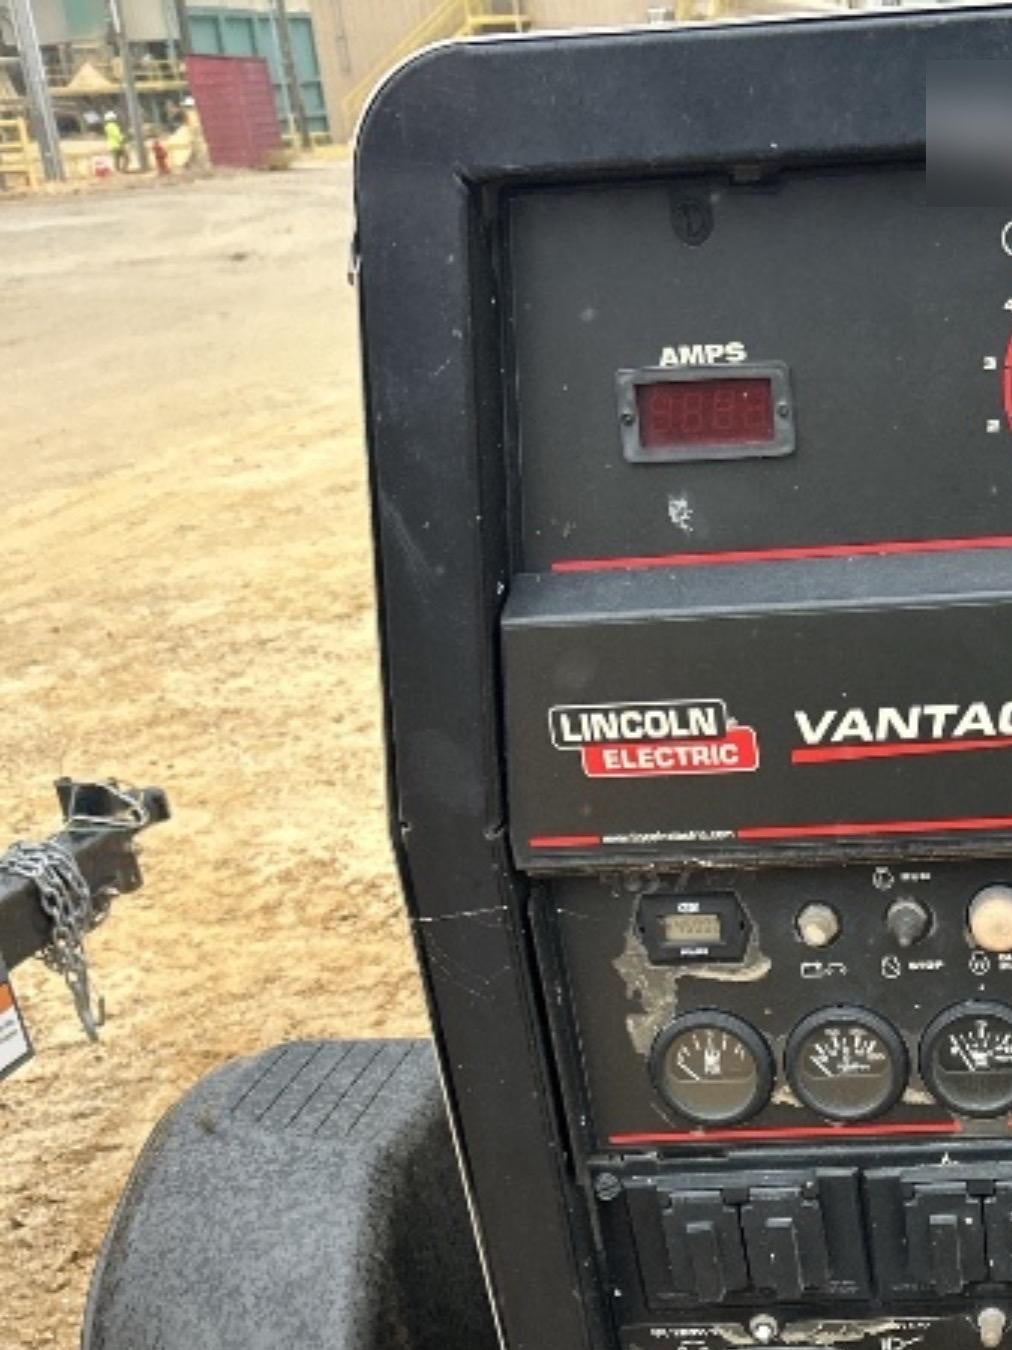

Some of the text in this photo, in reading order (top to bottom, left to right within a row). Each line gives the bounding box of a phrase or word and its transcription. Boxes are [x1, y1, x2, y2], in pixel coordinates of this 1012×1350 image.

[658, 341, 747, 366] AMPS
[982, 356, 997, 370] 3
[986, 420, 1000, 433] 2
[559, 706, 718, 742] LINCOLN
[603, 743, 739, 770] ELECTRIC
